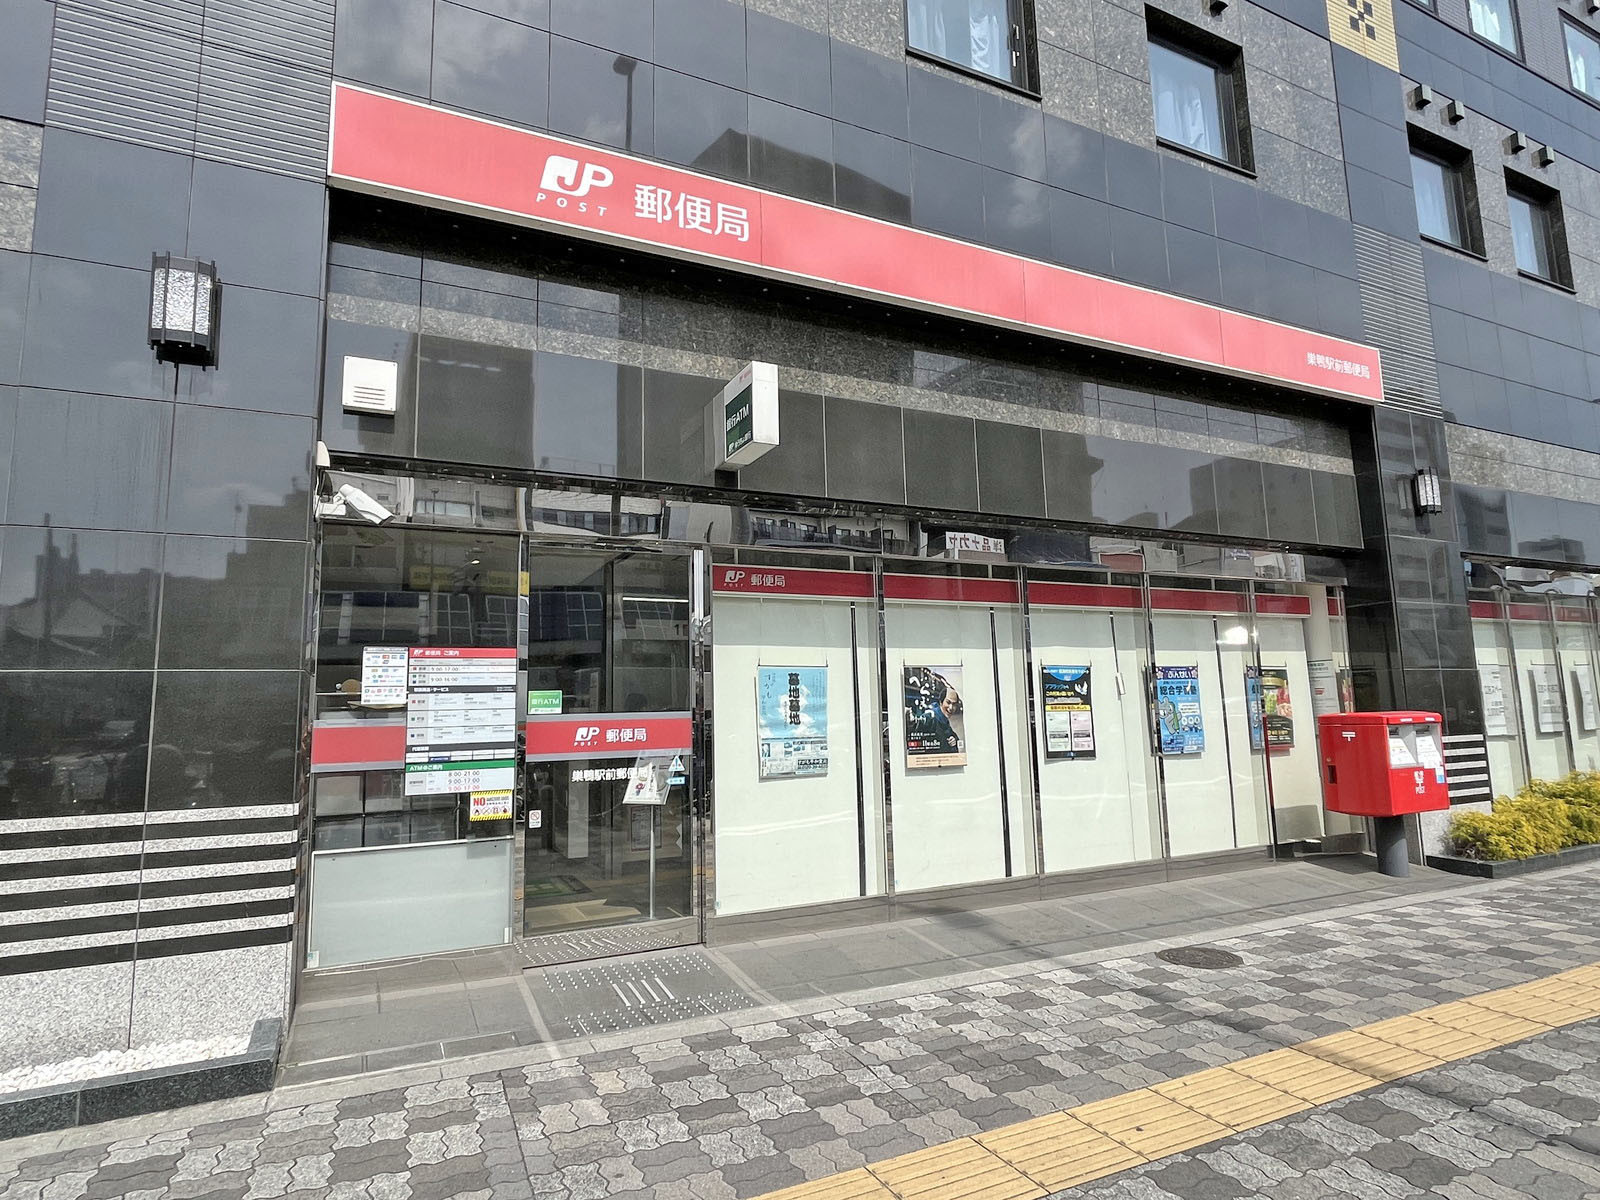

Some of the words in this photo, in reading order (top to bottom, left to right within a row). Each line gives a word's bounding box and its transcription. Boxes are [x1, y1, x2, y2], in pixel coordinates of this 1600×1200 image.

[536, 192, 607, 217] POST
[540, 155, 614, 197] JP
[634, 183, 749, 242] 郵便局
[1307, 352, 1371, 379] 巣鴨駅前郵便局
[750, 574, 786, 588] 郵便局
[575, 727, 600, 742] JP
[606, 728, 647, 743] 郵便局
[473, 797, 486, 806] NO
